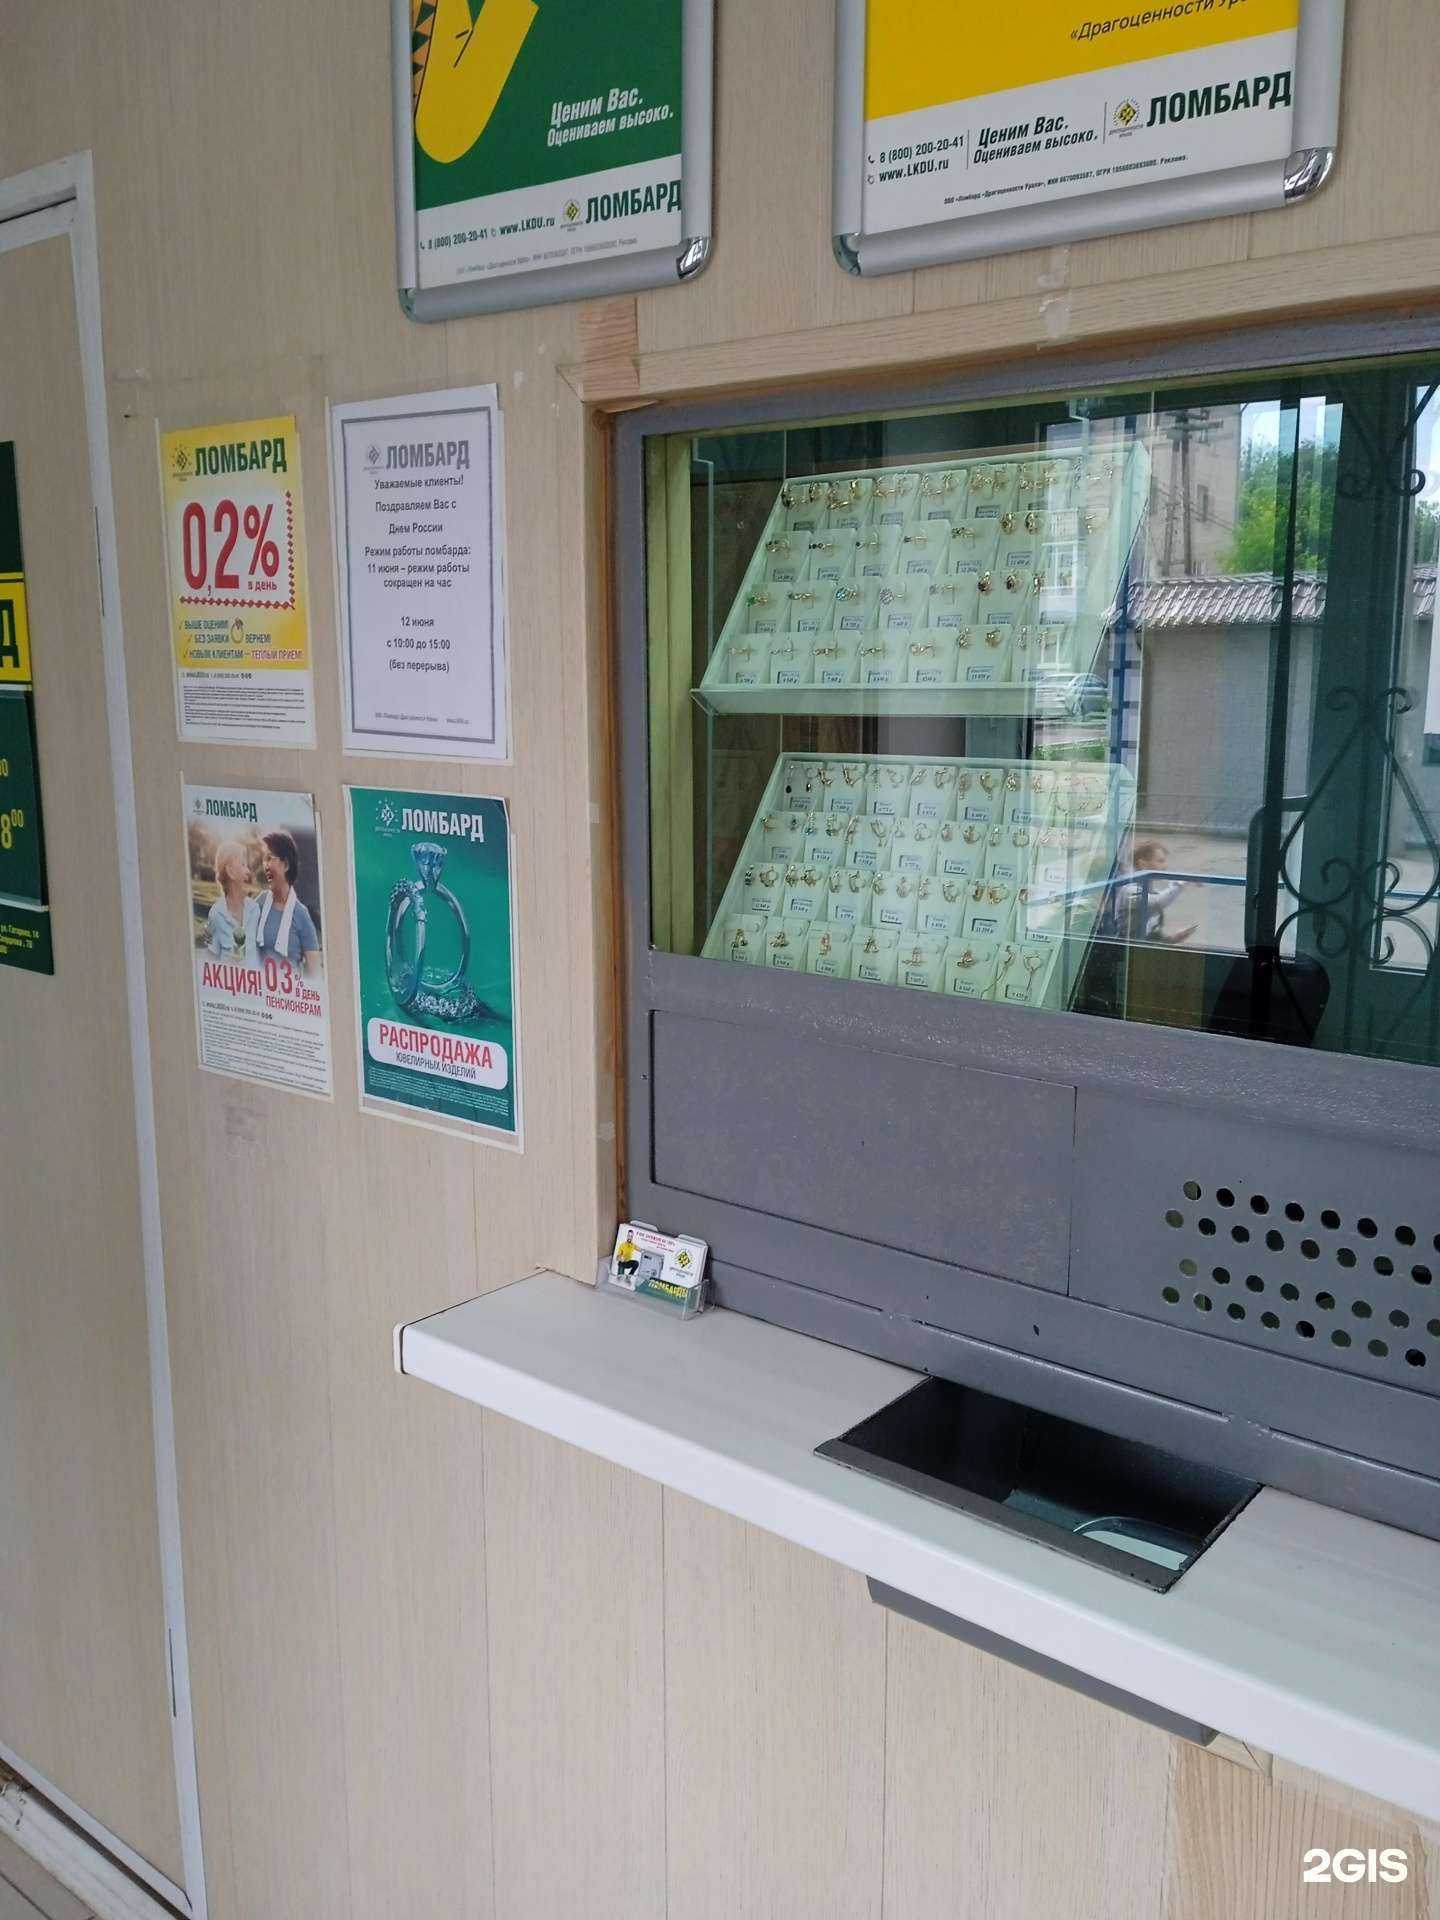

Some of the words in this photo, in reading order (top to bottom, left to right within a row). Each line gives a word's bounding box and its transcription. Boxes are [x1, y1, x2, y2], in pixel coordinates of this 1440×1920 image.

[1070, 0, 1214, 41] «Драгоценности
[550, 96, 604, 128] Ценим
[606, 88, 643, 112] Вас.
[1147, 71, 1291, 127] ЛОМБАРД
[547, 118, 616, 147] Оцениваем
[619, 104, 674, 130] высоко.
[978, 124, 1028, 148] Ценим
[1033, 115, 1068, 135] Вас.
[879, 152, 885, 163] 8
[889, 147, 912, 163] (800)
[915, 135, 964, 156] 200-20-41
[973, 141, 1040, 164] Оцениваем
[1045, 129, 1097, 150] высоко.
[879, 158, 949, 182] www.LKDU.ru
[586, 180, 681, 224] ЛОМБАРД
[453, 228, 488, 246] 200-20-41
[499, 217, 555, 235] www.LKDU.ru
[195, 438, 287, 476] ЛОМБАРД
[386, 440, 469, 470] ЛОМБАРД
[374, 479, 422, 490] Уважаемые
[424, 475, 464, 487] клиенты!
[375, 500, 431, 513] Поздравляем
[433, 499, 449, 510] Вас
[451, 501, 457, 509] с
[389, 523, 410, 535] Днем
[412, 522, 443, 533] России
[364, 546, 391, 557] Режим
[392, 545, 423, 558] работы
[425, 545, 471, 557] ломбарда:
[368, 563, 376, 573] 11
[378, 565, 399, 574] июня
[407, 565, 434, 575] режим
[436, 562, 470, 574] работы
[255, 581, 277, 592] день
[384, 579, 422, 590] сокращен
[424, 579, 434, 587] на
[437, 579, 452, 588] час
[400, 616, 410, 627] 12
[412, 617, 434, 627] июня
[387, 640, 392, 648] с
[393, 638, 414, 649] 10:00
[416, 640, 427, 650] до
[429, 639, 451, 650] 15:00
[389, 659, 405, 671] (без
[406, 661, 450, 674] перерыва)
[206, 799, 257, 822] ЛОМБАРД
[402, 808, 484, 843] ЛОМБАРД
[202, 962, 262, 997] АКЦИЯ!
[266, 995, 321, 1017] ПЕНСИОНЕРАМ
[302, 989, 320, 1001] ДЕНЬ
[379, 1023, 493, 1069] РАСПРОДАЖА
[395, 1051, 440, 1071] ЮВЕЛИРНЫХ
[441, 1062, 476, 1079] ИЗДЕЛИЙ
